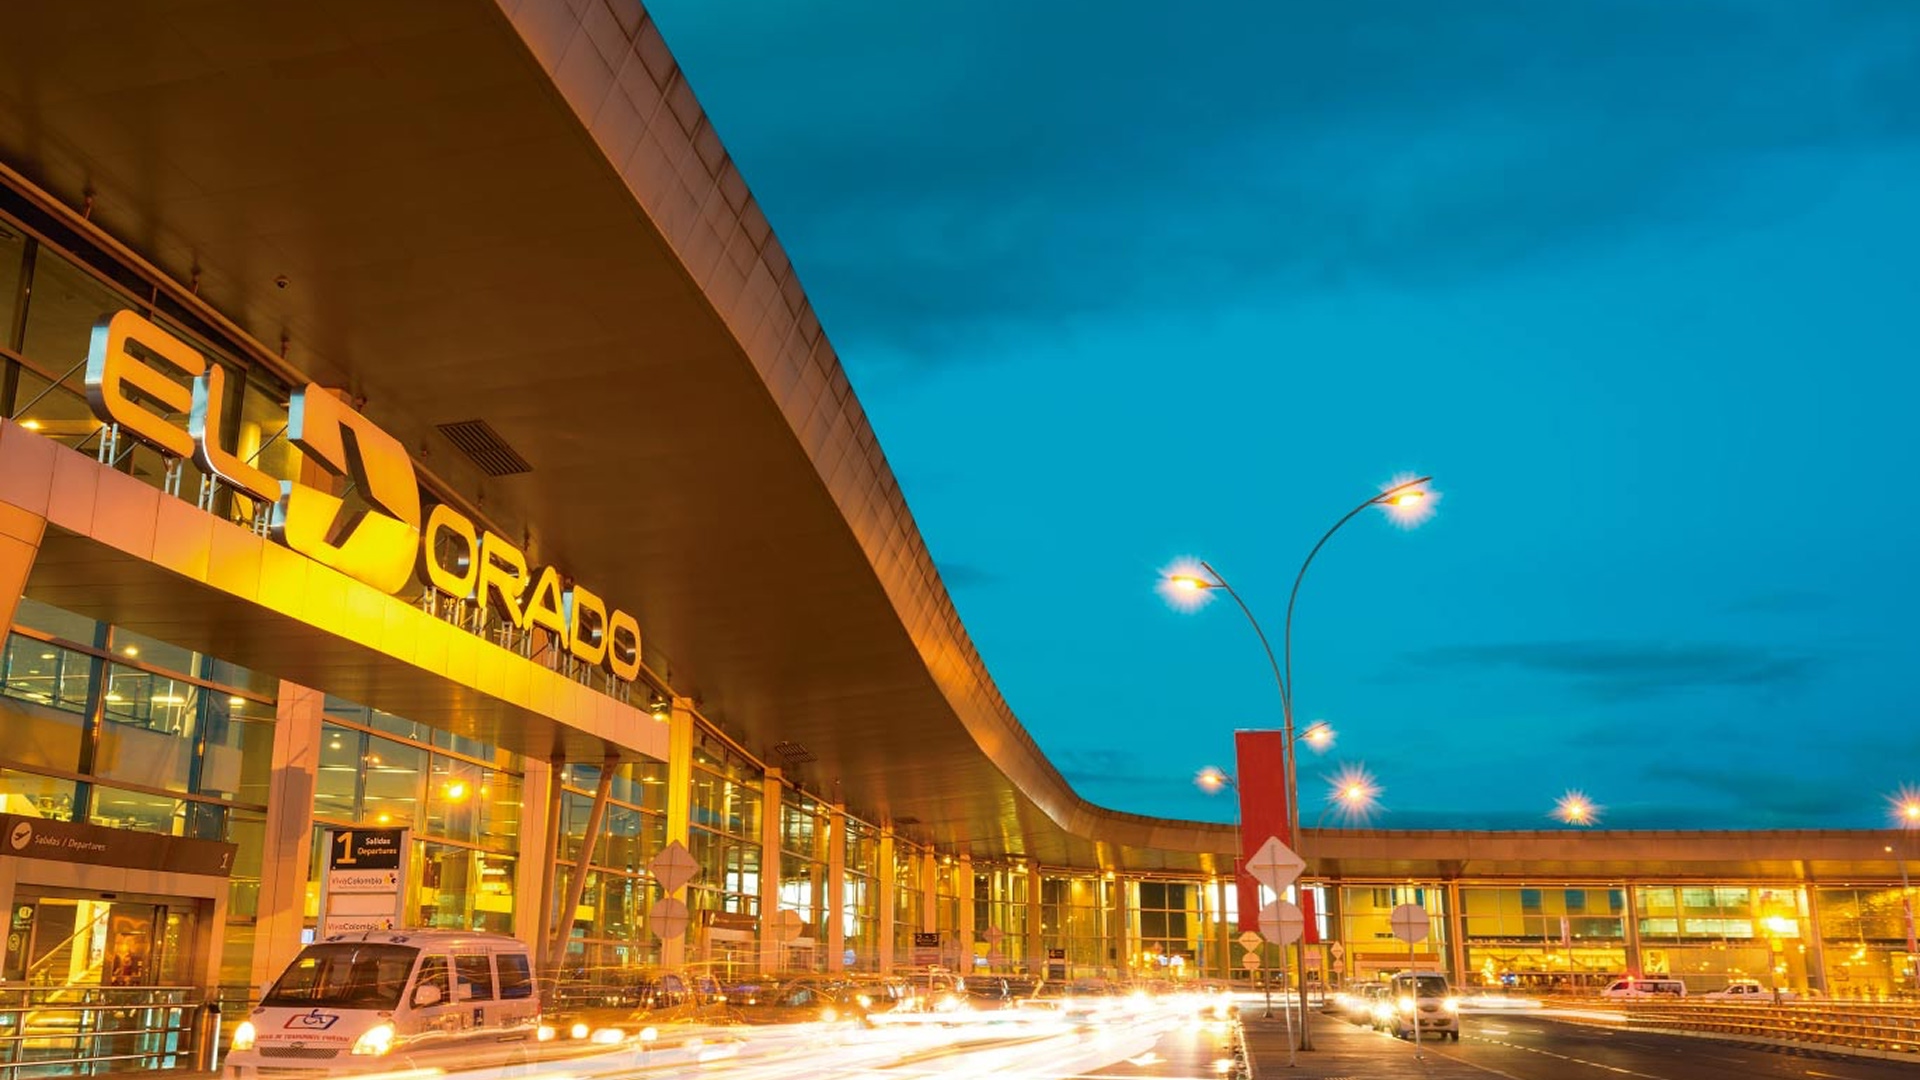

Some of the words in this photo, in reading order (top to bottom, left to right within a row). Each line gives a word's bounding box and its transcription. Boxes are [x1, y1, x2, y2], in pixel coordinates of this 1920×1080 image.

[86, 309, 281, 503] EL
[272, 381, 642, 682] DORADO
[34, 834, 60, 847] Salidas
[68, 837, 106, 851] Departures
[336, 831, 357, 864] 1
[365, 837, 391, 845] Salidas
[357, 847, 397, 856] Departures
[219, 852, 230, 869] 1
